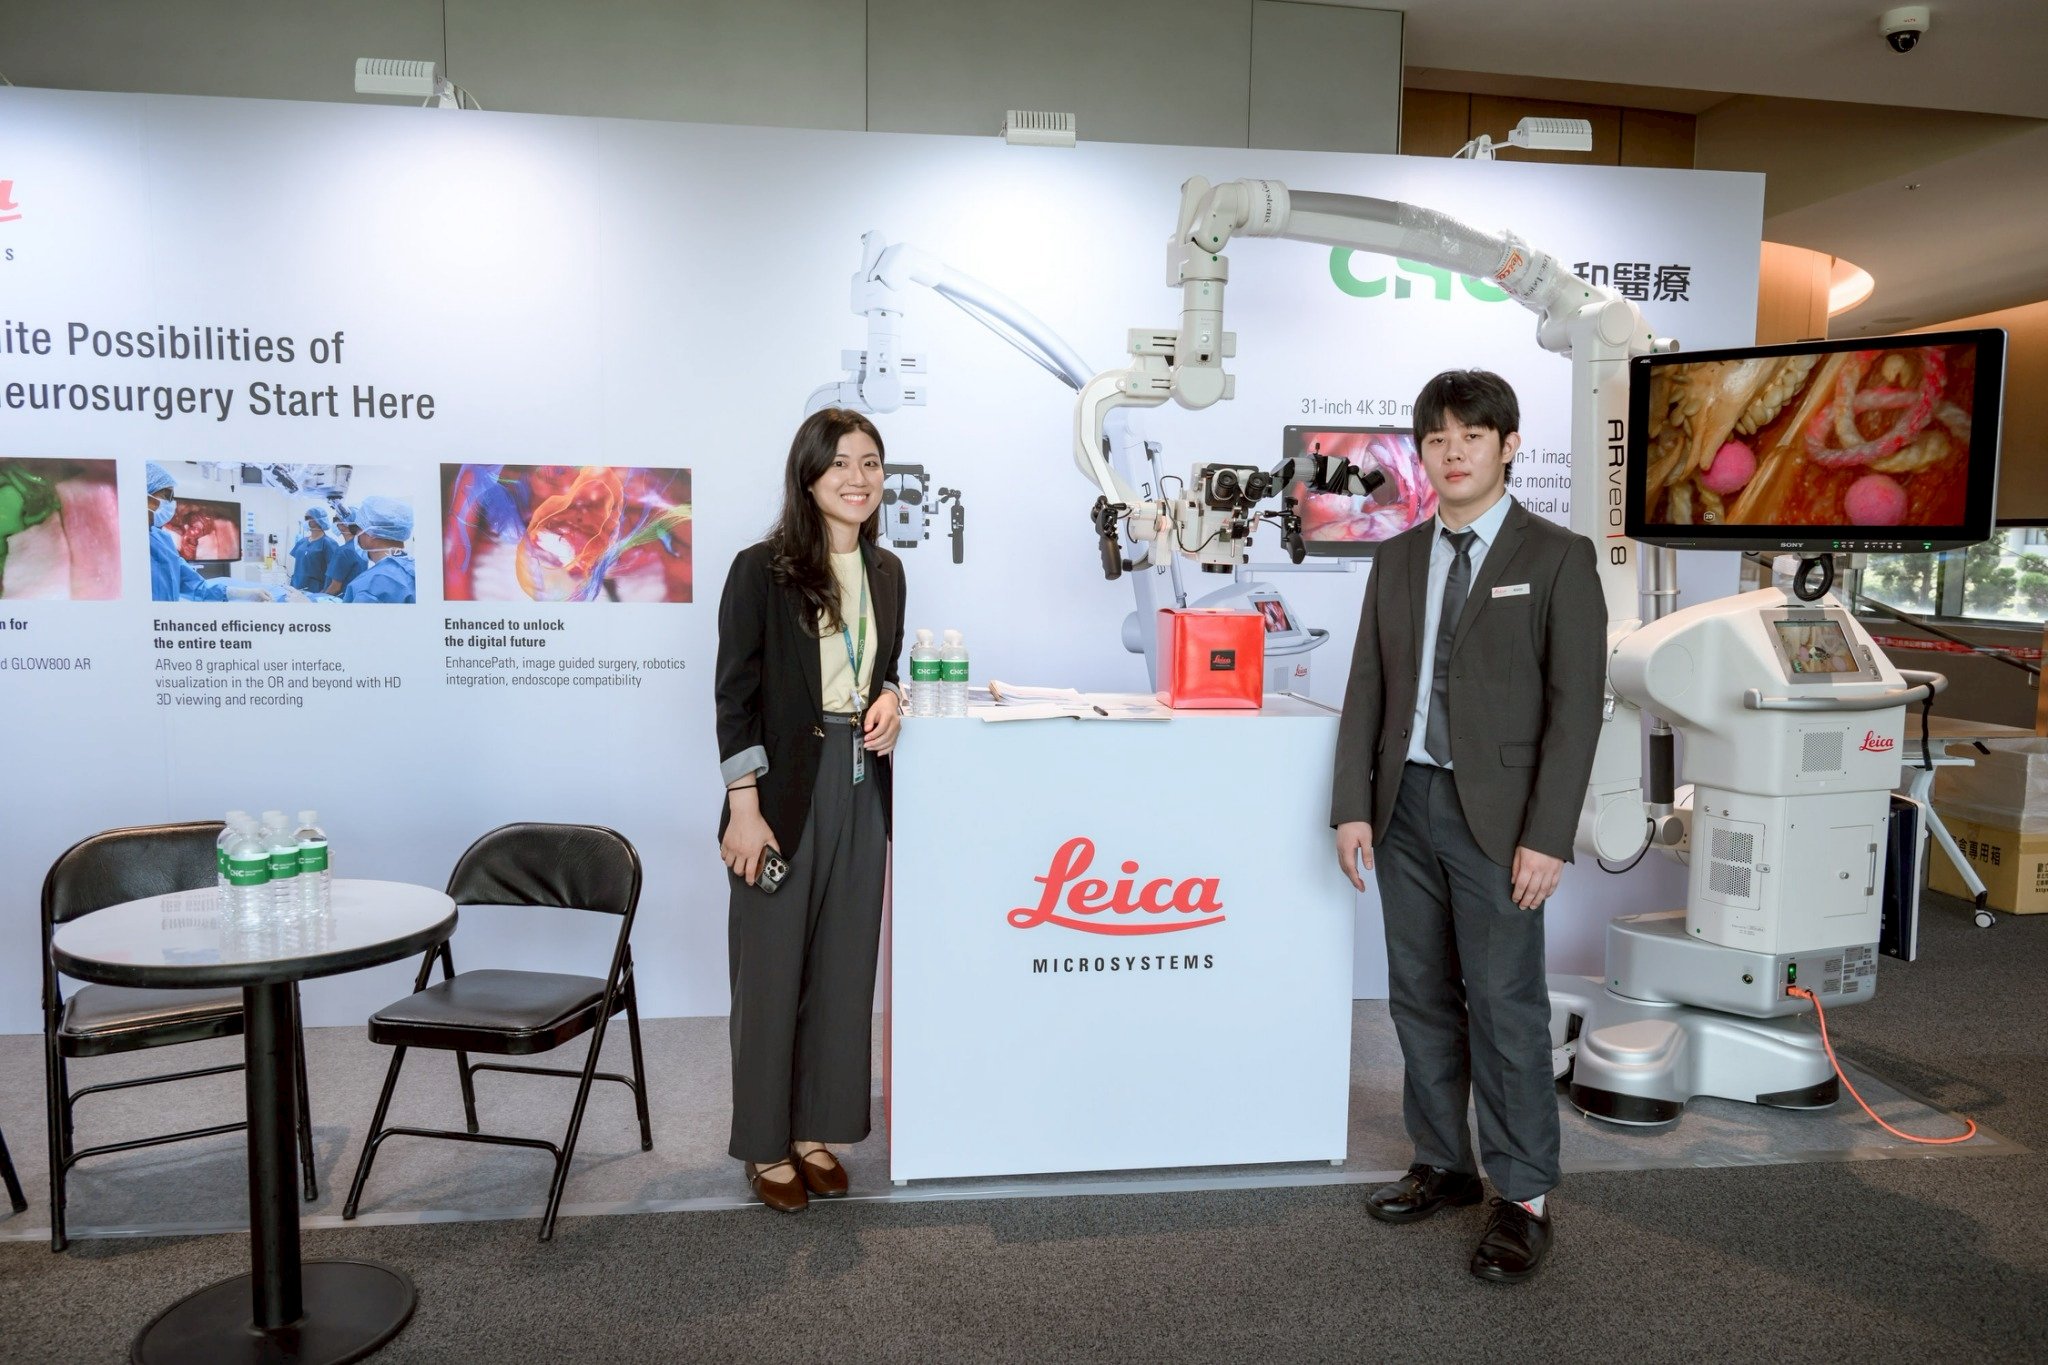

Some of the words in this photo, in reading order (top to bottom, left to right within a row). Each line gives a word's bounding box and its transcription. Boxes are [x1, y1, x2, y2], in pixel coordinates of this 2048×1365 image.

[68, 322, 295, 363] Possibilities
[310, 331, 344, 364] of
[0, 382, 233, 422] eurosurgery
[249, 383, 339, 417] Start
[353, 386, 435, 420] Here
[1301, 398, 1352, 415] 31-inch
[1356, 399, 1374, 415] 4K
[1378, 400, 1397, 416] 3D
[1526, 473, 1571, 489] monito
[1608, 419, 1625, 527] ARveo
[10, 618, 28, 631] for
[154, 619, 217, 633] Enhanced
[221, 620, 285, 634] efficiency
[289, 623, 331, 633] across
[445, 618, 505, 630] Enhanced
[508, 620, 520, 631] to
[523, 619, 565, 631] unlock
[154, 637, 174, 649] the
[178, 637, 216, 650] entire
[219, 639, 252, 650] team
[444, 635, 464, 648] the
[468, 635, 506, 650] digital
[510, 636, 546, 648] future
[11, 657, 70, 671] GLOW800
[74, 658, 91, 672] AR
[155, 659, 192, 672] ARveo
[196, 660, 203, 672] 8
[206, 658, 260, 675] graphical
[264, 662, 288, 672] user
[292, 659, 345, 674] interface,
[445, 656, 518, 671] EnhancePath,
[522, 657, 555, 671] image
[558, 657, 595, 671] guided
[598, 660, 639, 672] surgery,
[643, 658, 685, 670] robotics
[156, 676, 228, 689] visualization
[232, 676, 242, 689] in
[246, 676, 264, 689] the
[268, 676, 284, 689] OR
[288, 676, 309, 689] and
[312, 676, 352, 690] beyond
[356, 677, 381, 689] with
[385, 677, 401, 689] HD
[446, 673, 508, 688] integration,
[512, 674, 569, 688] endoscope
[573, 675, 642, 688] compatibility
[156, 693, 172, 706] 3D
[175, 693, 221, 708] viewing
[225, 693, 246, 706] and
[250, 693, 303, 708] recording
[1859, 730, 1894, 752] Leica
[1007, 837, 1226, 936] Leica
[1033, 954, 1214, 973] MICROSYSTEMS
